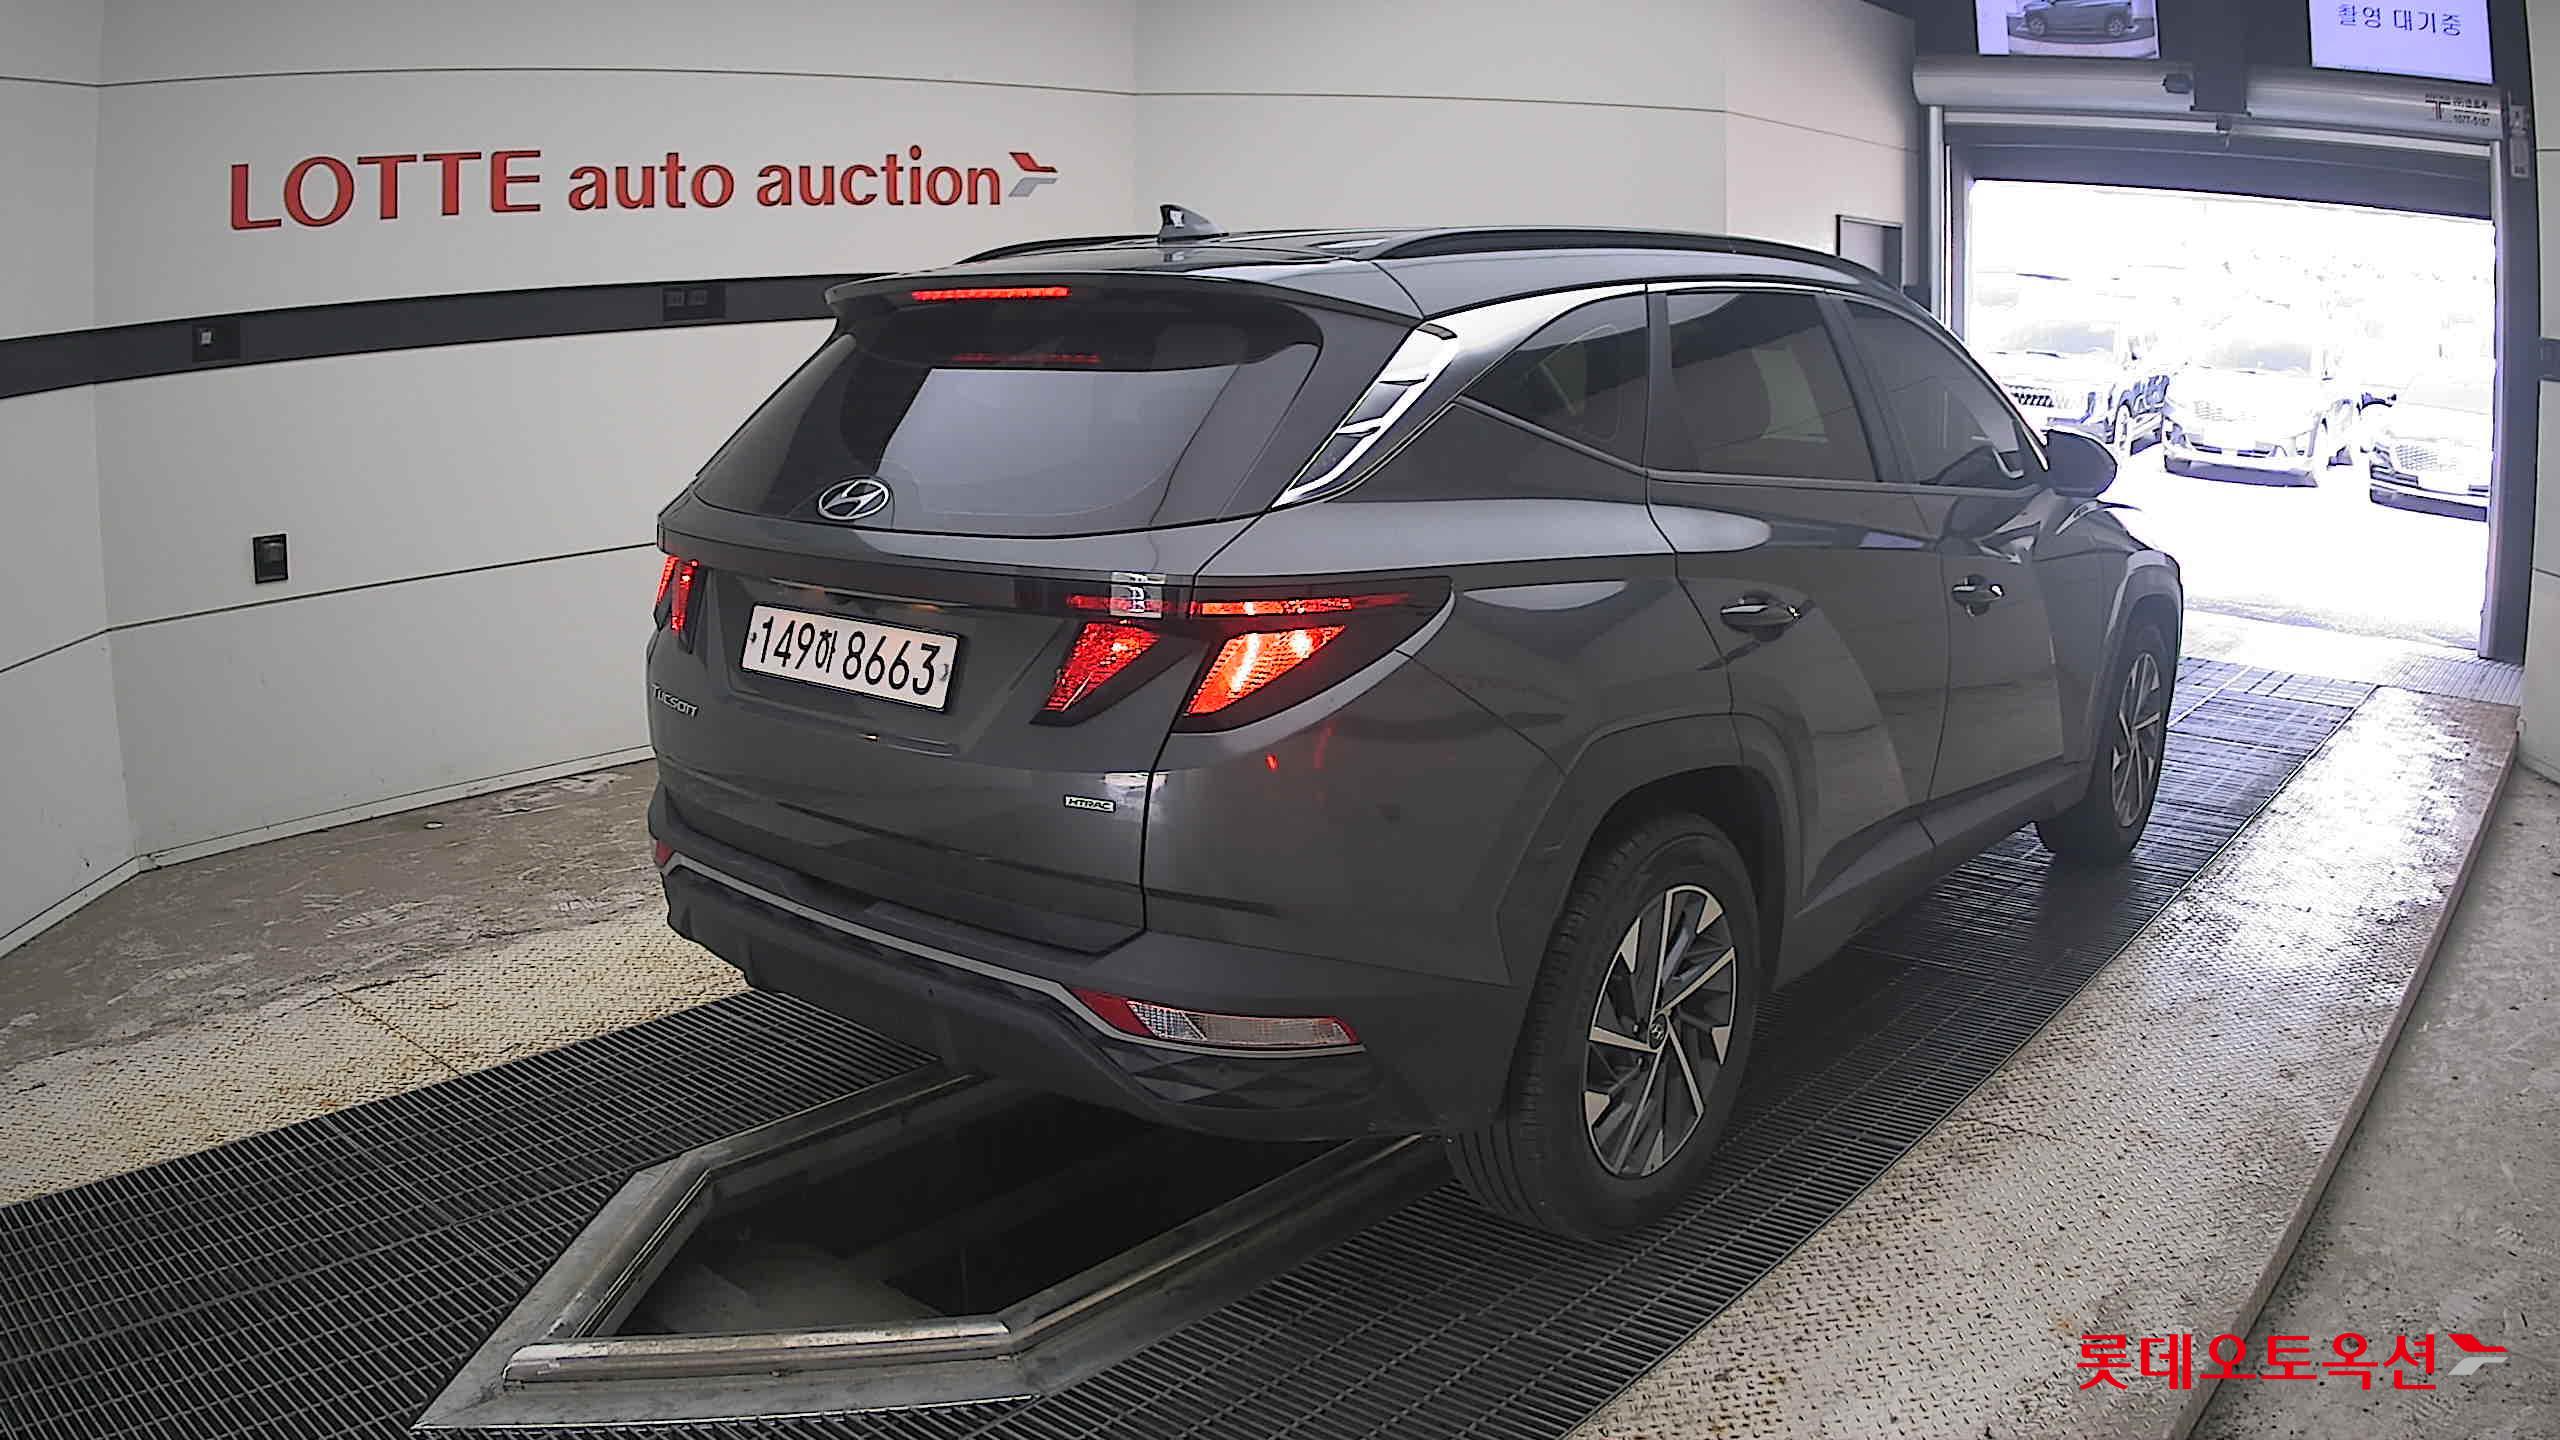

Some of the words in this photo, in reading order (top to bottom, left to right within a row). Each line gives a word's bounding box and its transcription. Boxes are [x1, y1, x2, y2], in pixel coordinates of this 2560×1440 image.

[2393, 9, 2462, 36] 대기중
[229, 149, 542, 231] LOTTE
[568, 151, 737, 210] auto
[757, 144, 1002, 208] auction
[761, 616, 838, 672] 149하
[842, 631, 941, 695] 8663
[651, 683, 698, 717] TUCSON
[1066, 798, 1113, 811] HTRAC
